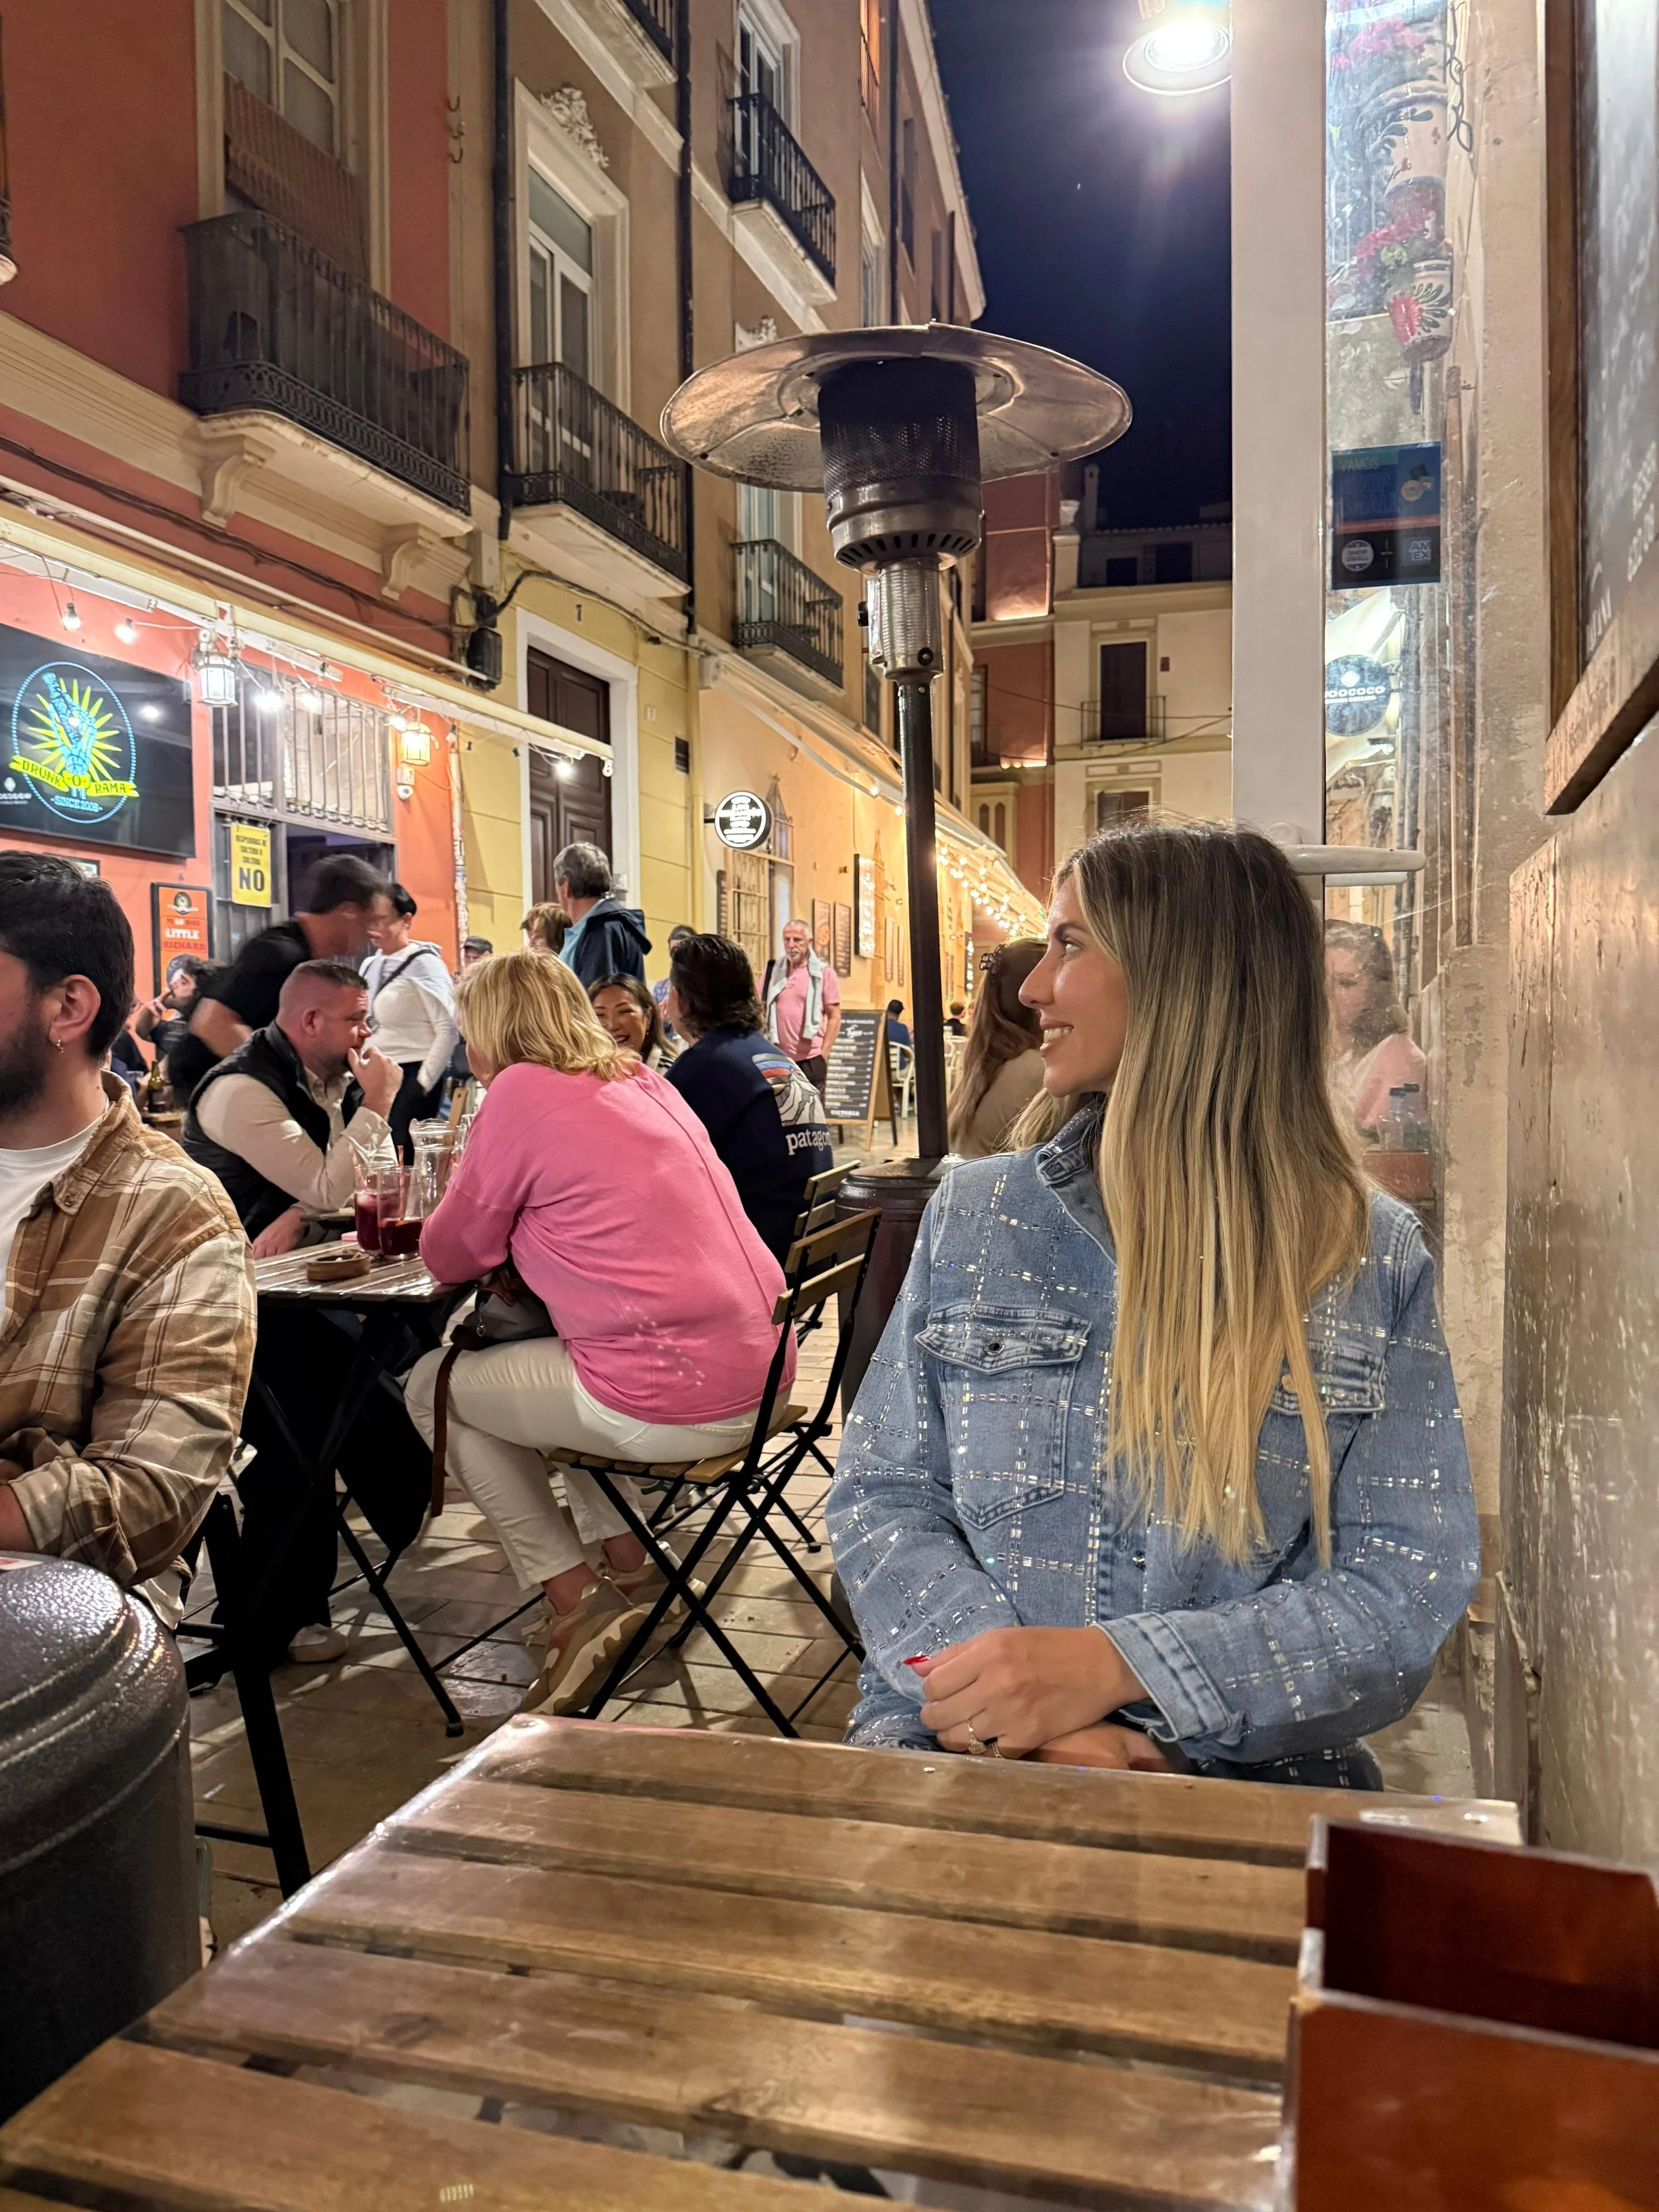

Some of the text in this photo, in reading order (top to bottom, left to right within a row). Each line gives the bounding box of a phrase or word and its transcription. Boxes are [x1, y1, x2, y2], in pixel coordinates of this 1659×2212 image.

[22, 760, 61, 787] DRUNK
[95, 783, 127, 794] RAMA
[239, 867, 265, 892] NO
[165, 928, 200, 940] LITTLE
[163, 941, 206, 950] RICHARD
